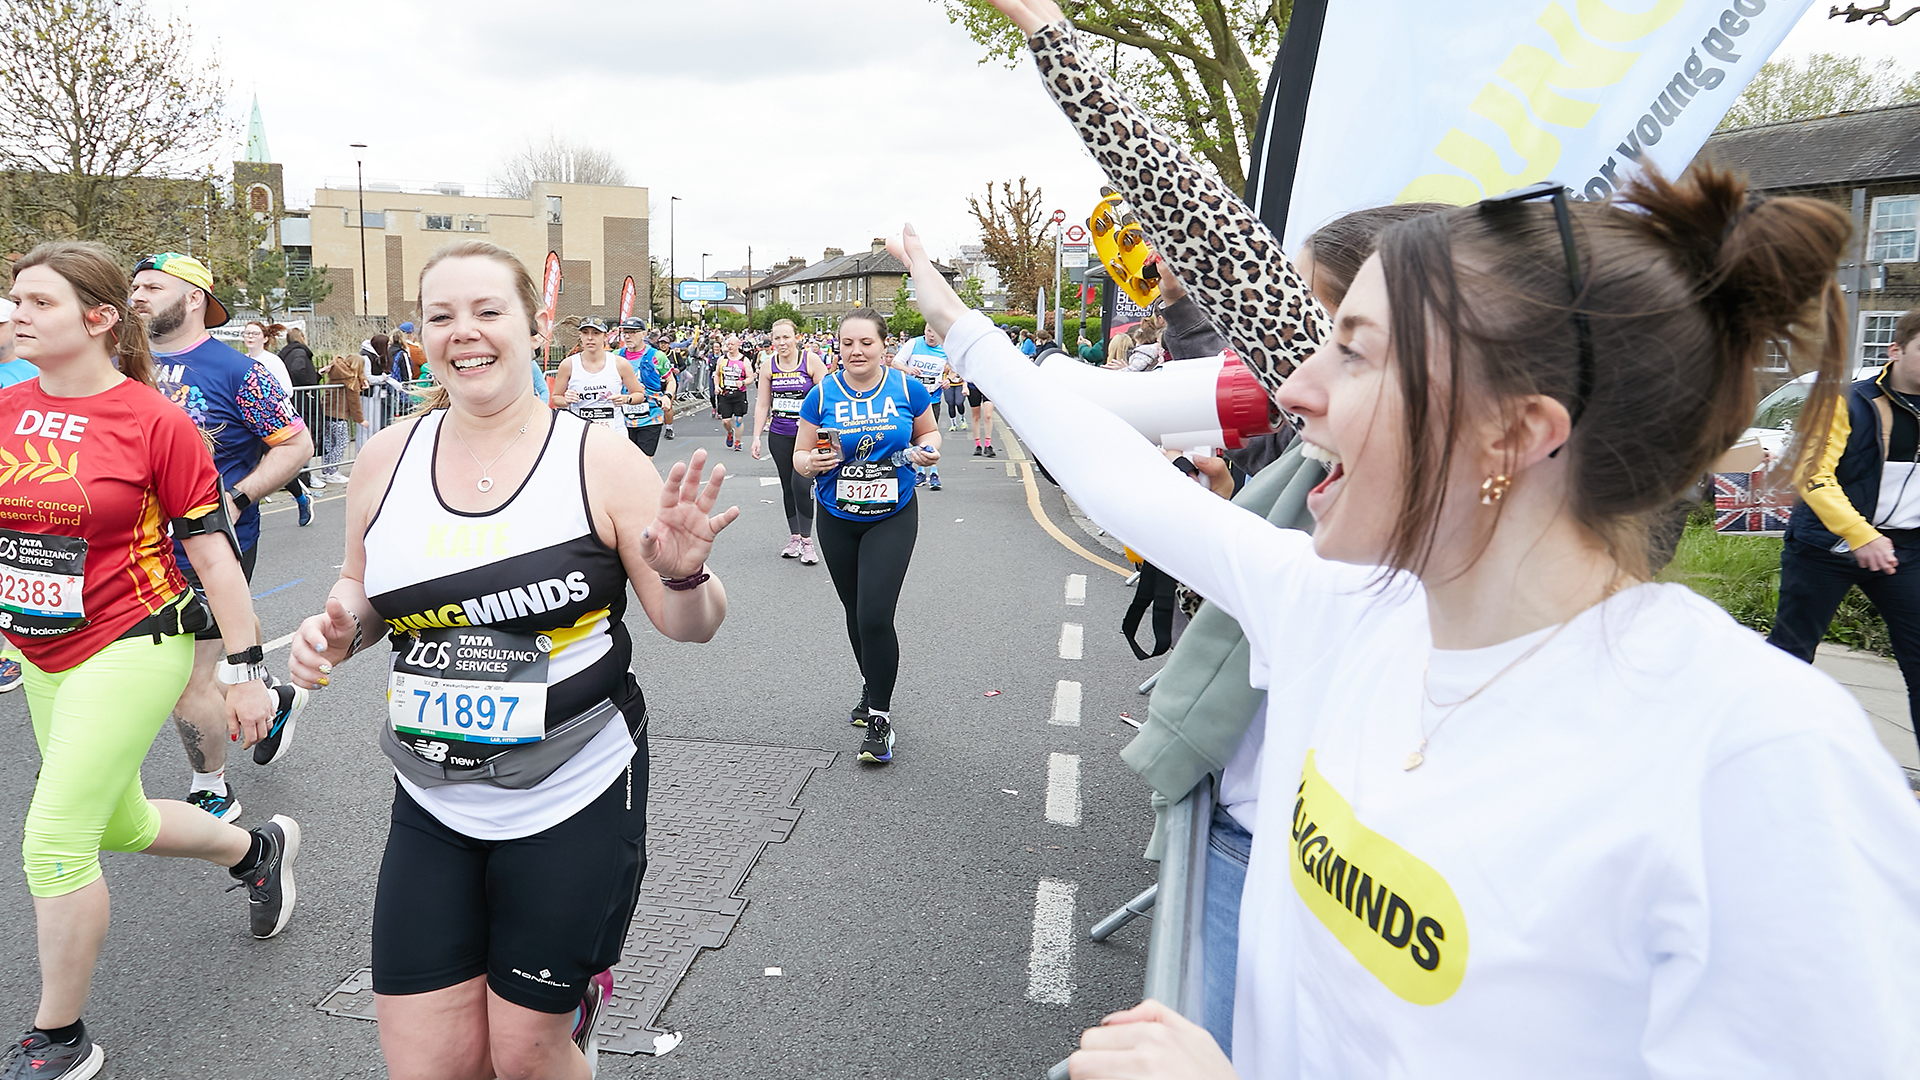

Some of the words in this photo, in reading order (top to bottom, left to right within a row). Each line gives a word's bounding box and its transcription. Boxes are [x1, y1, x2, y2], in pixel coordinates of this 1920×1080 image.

[913, 360, 938, 370] JDRF
[583, 384, 607, 392] GILLIAN
[835, 396, 900, 423] ELLA
[14, 409, 90, 443] DEE
[862, 424, 898, 432] Foundation
[846, 484, 888, 499] 31272
[36, 500, 85, 513] cancer
[49, 512, 81, 526] fund
[424, 522, 509, 558] KATE
[19, 547, 78, 560] CONSULTANCY
[19, 555, 54, 567] SERVICES
[13, 624, 30, 635] new
[31, 626, 76, 635] balance
[458, 635, 494, 647] TATA
[456, 648, 540, 663] CONSULTANCY
[455, 660, 508, 673] SERVICES
[413, 689, 519, 731] 71897
[450, 756, 475, 766] new
